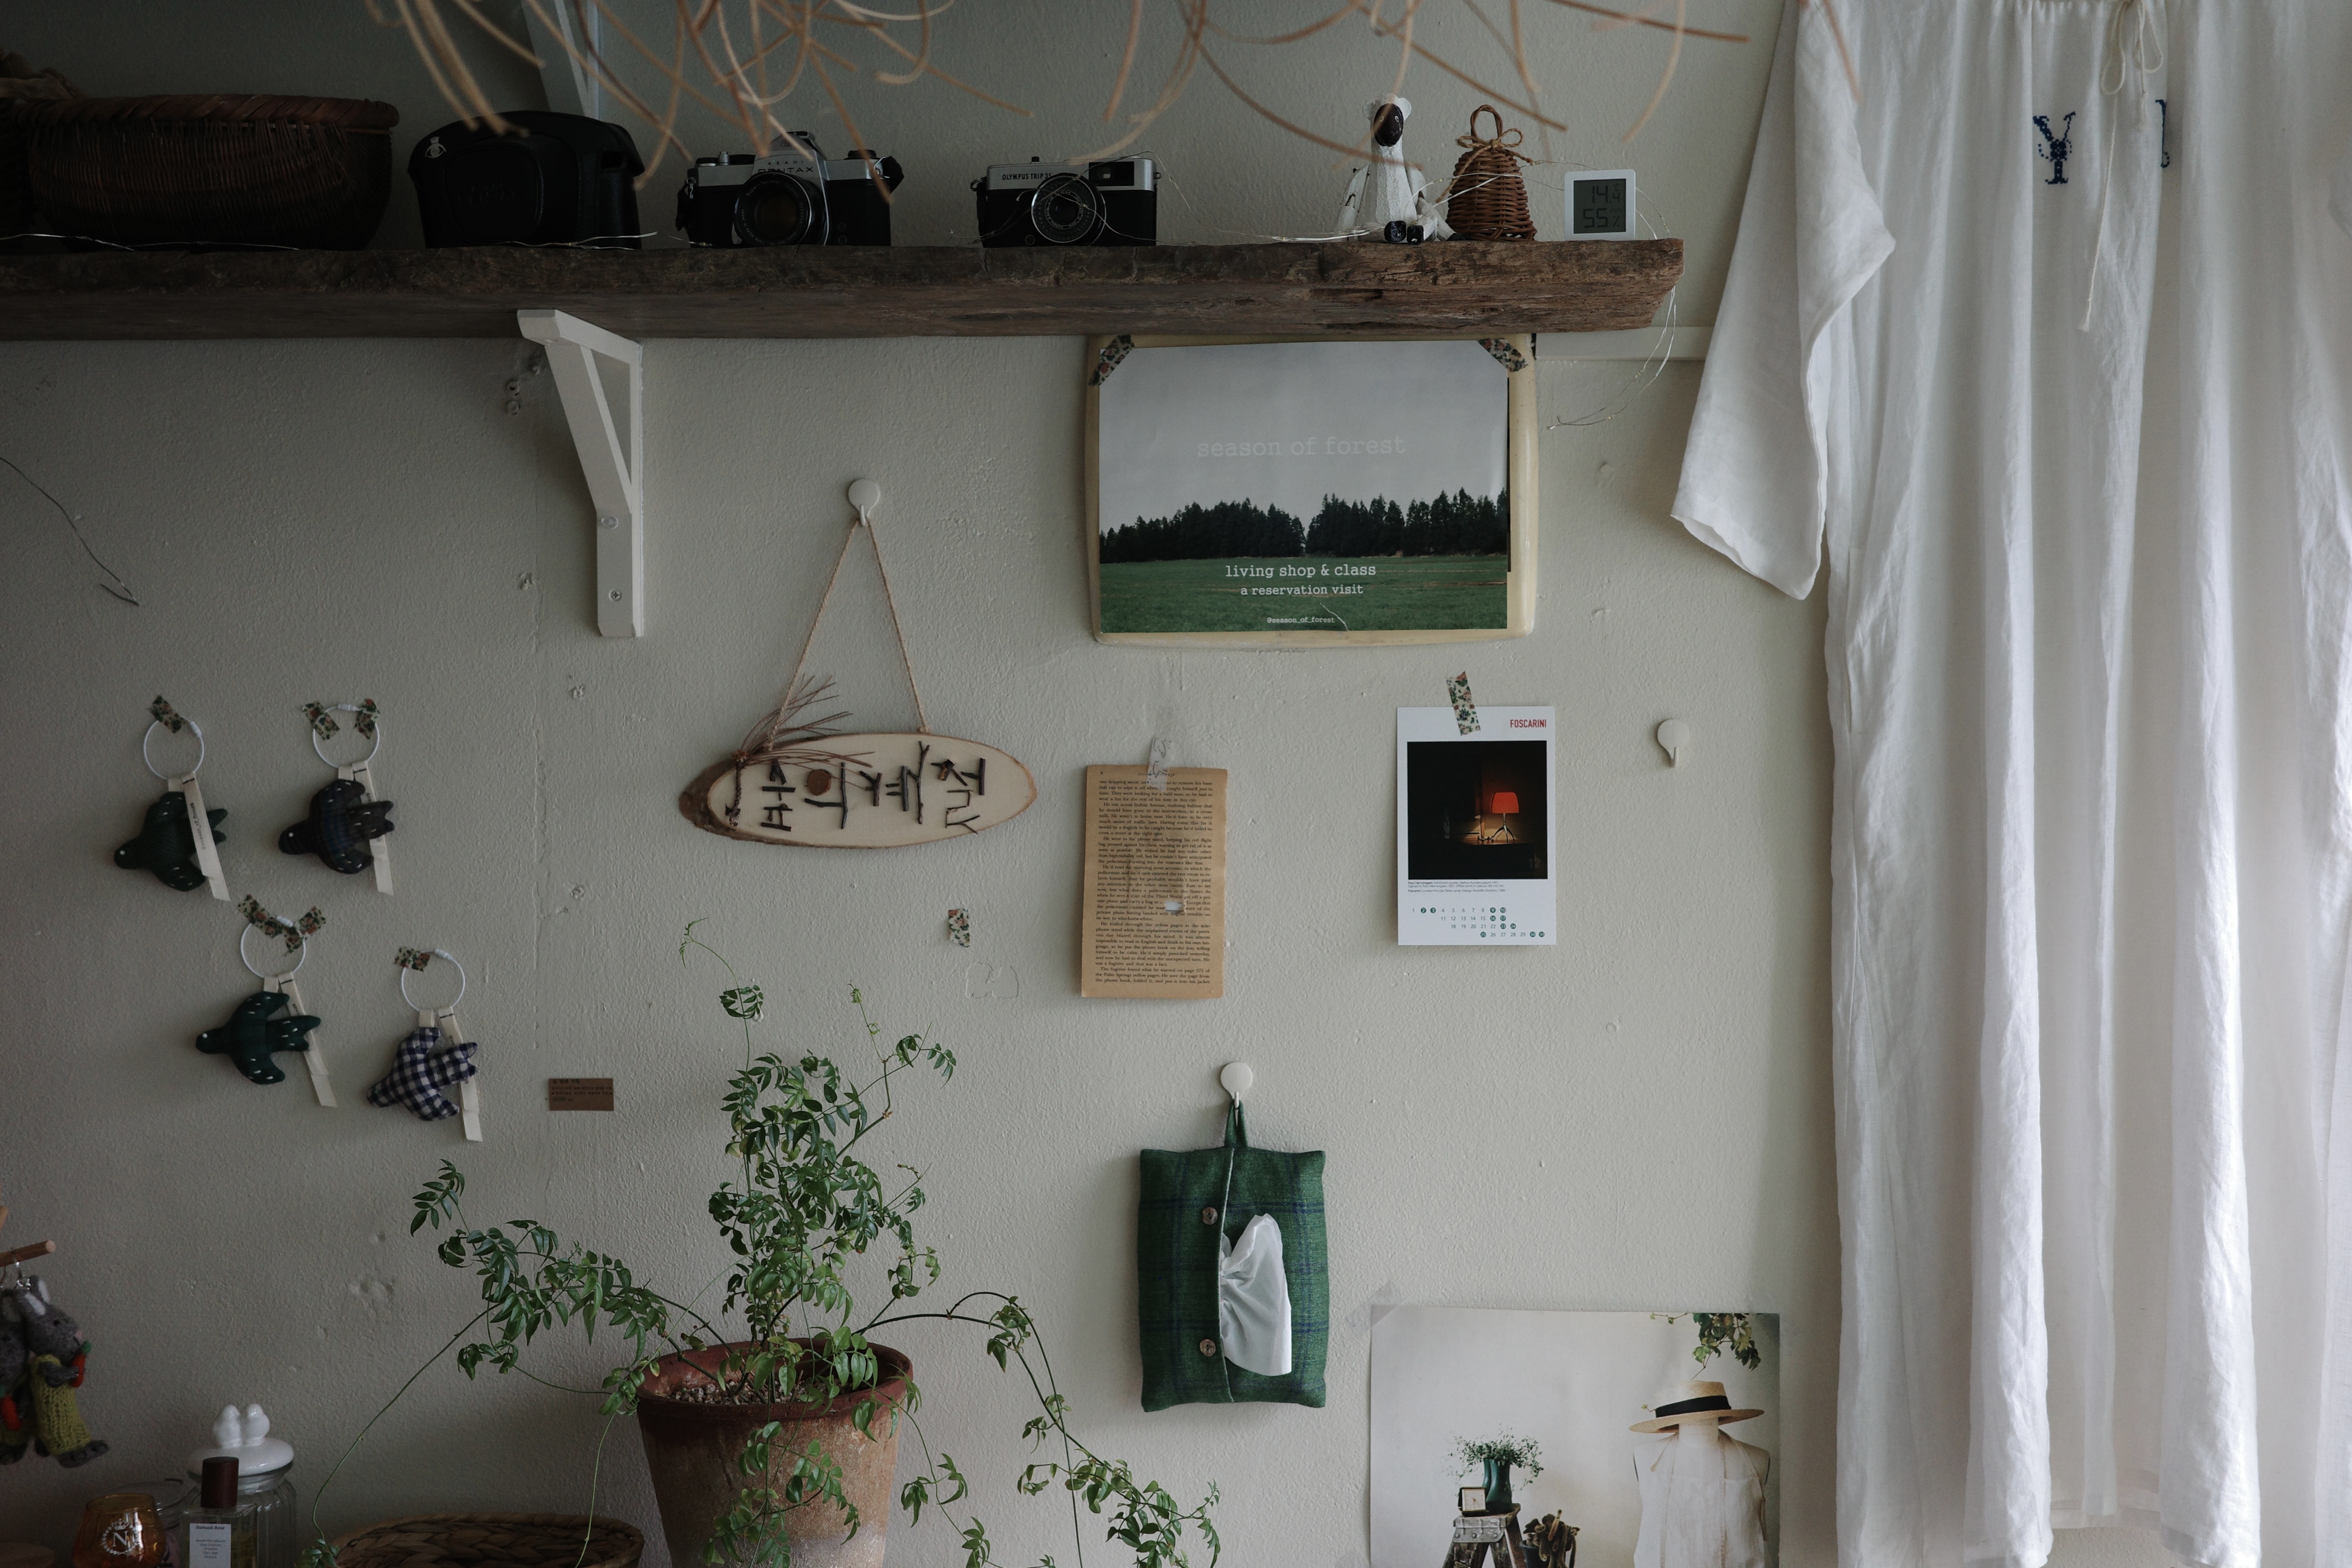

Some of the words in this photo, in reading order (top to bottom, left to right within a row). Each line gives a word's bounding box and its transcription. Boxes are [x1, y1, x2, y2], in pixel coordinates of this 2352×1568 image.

[1198, 441, 1282, 457] season
[1291, 437, 1316, 455] of
[1325, 435, 1405, 455] forest
[1226, 565, 1274, 578] living
[1279, 565, 1316, 578] shop
[1321, 564, 1330, 576] &
[1334, 564, 1376, 576] class
[1241, 587, 1248, 595] a
[1251, 584, 1328, 595] reservation
[1332, 584, 1363, 594] visit
[1510, 719, 1547, 728] FOSCARINI
[112, 1531, 128, 1547] N
